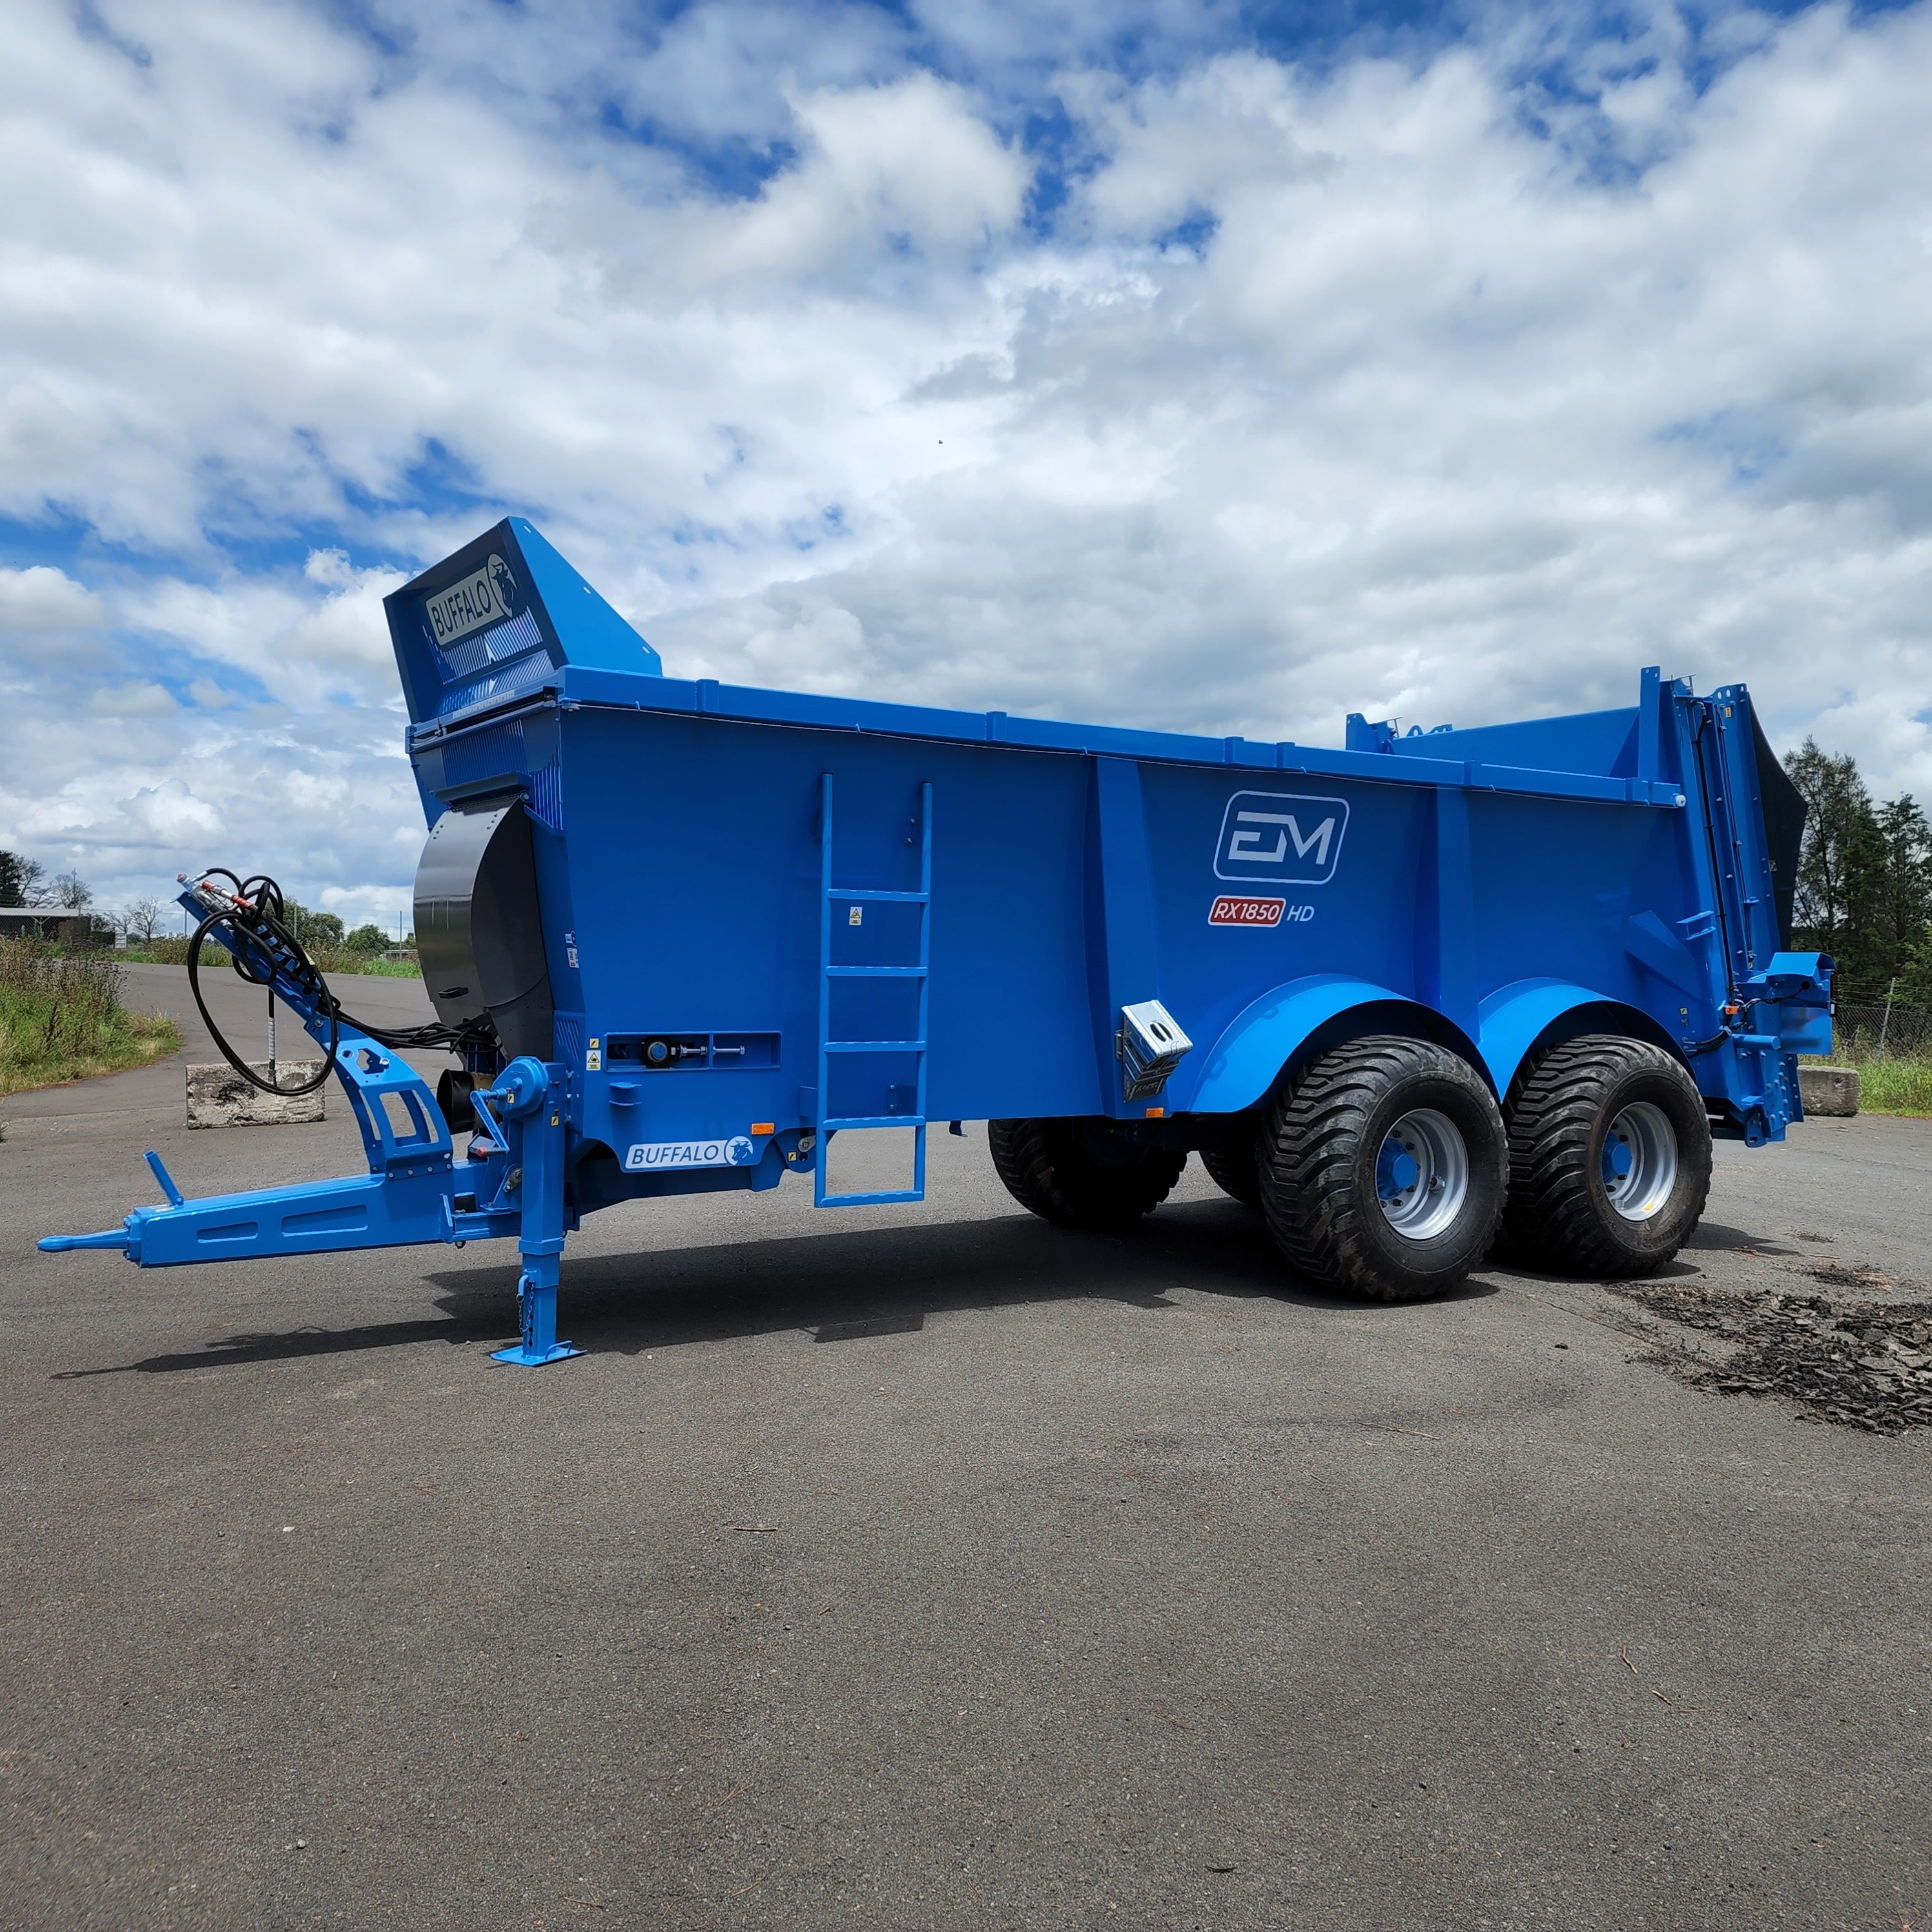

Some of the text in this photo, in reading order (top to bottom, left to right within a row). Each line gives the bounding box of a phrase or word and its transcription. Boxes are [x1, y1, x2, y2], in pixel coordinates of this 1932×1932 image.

[431, 580, 491, 637] BUFFALO
[1228, 811, 1335, 865] EM
[1214, 902, 1315, 921] RX1850 HD
[632, 1145, 719, 1164] BUFFALO
